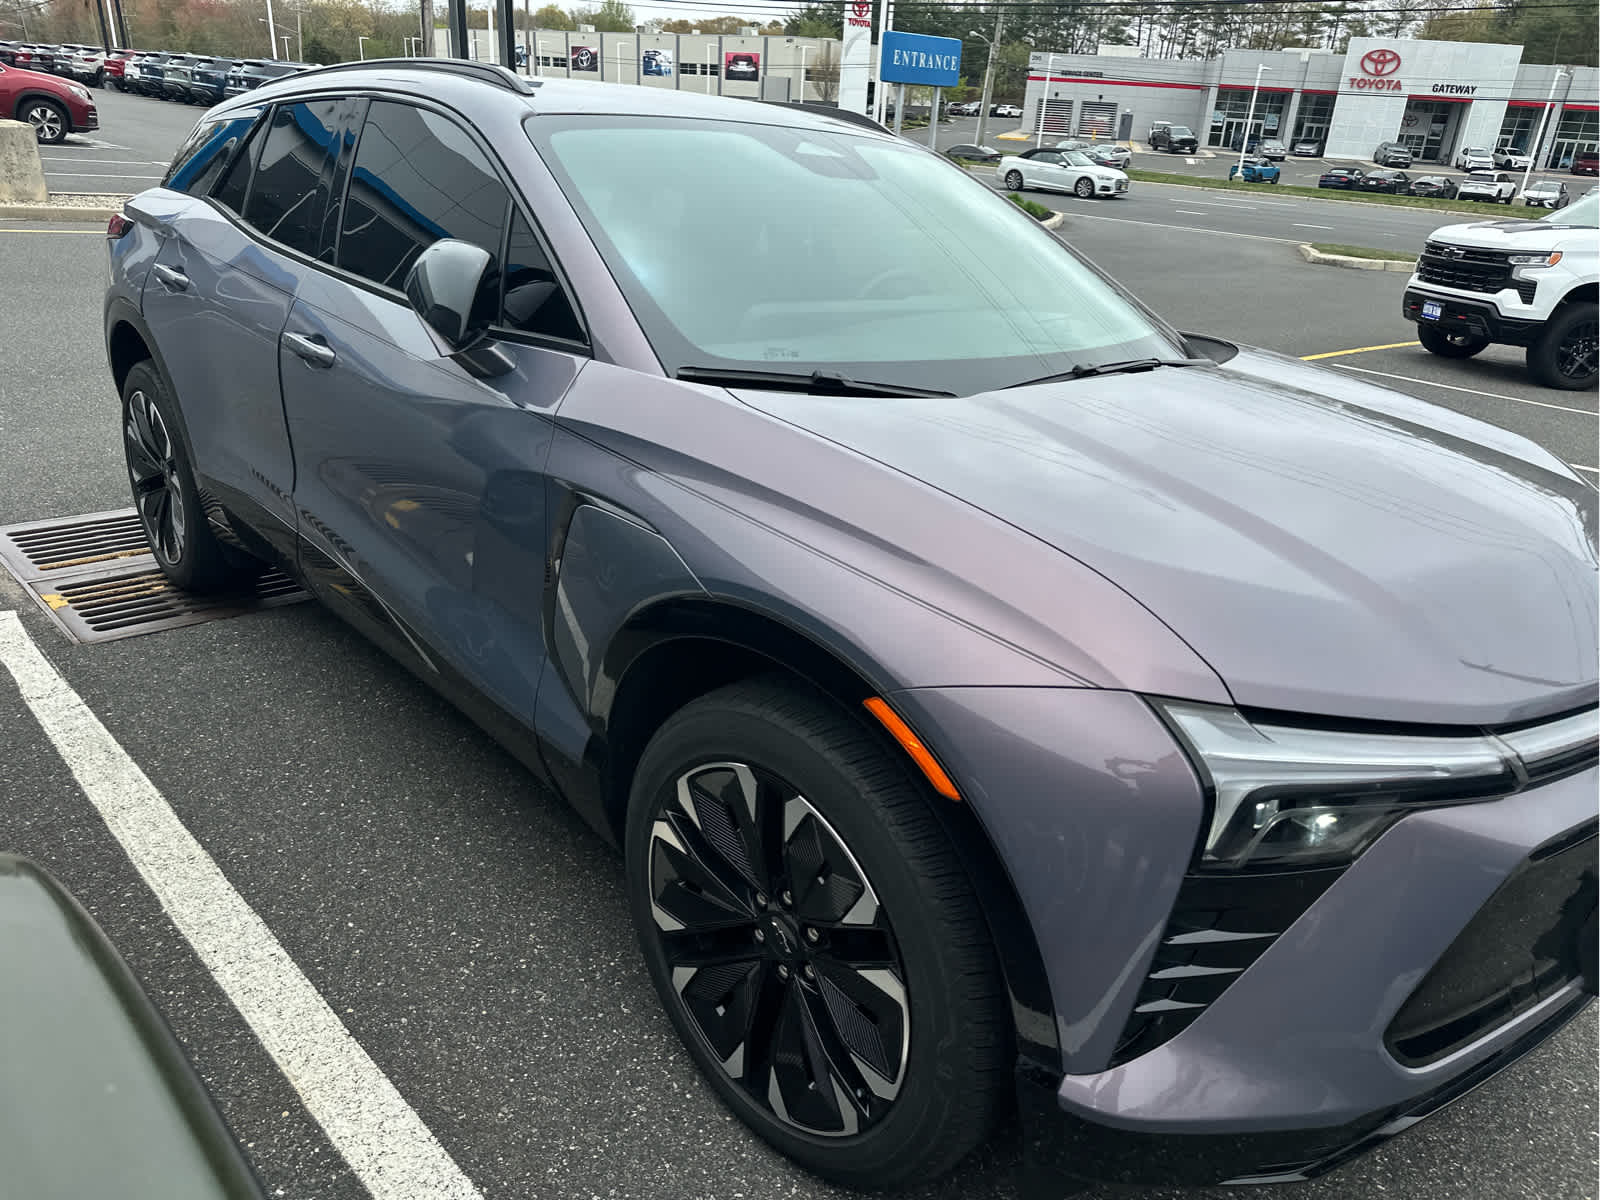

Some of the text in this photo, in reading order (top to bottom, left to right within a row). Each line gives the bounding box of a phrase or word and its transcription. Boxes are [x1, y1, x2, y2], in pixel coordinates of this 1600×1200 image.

[848, 18, 871, 27] TOYOTA
[893, 49, 958, 71] ENTRANCE
[1349, 78, 1402, 91] TOYOTA
[1432, 83, 1477, 95] GATEWAY
